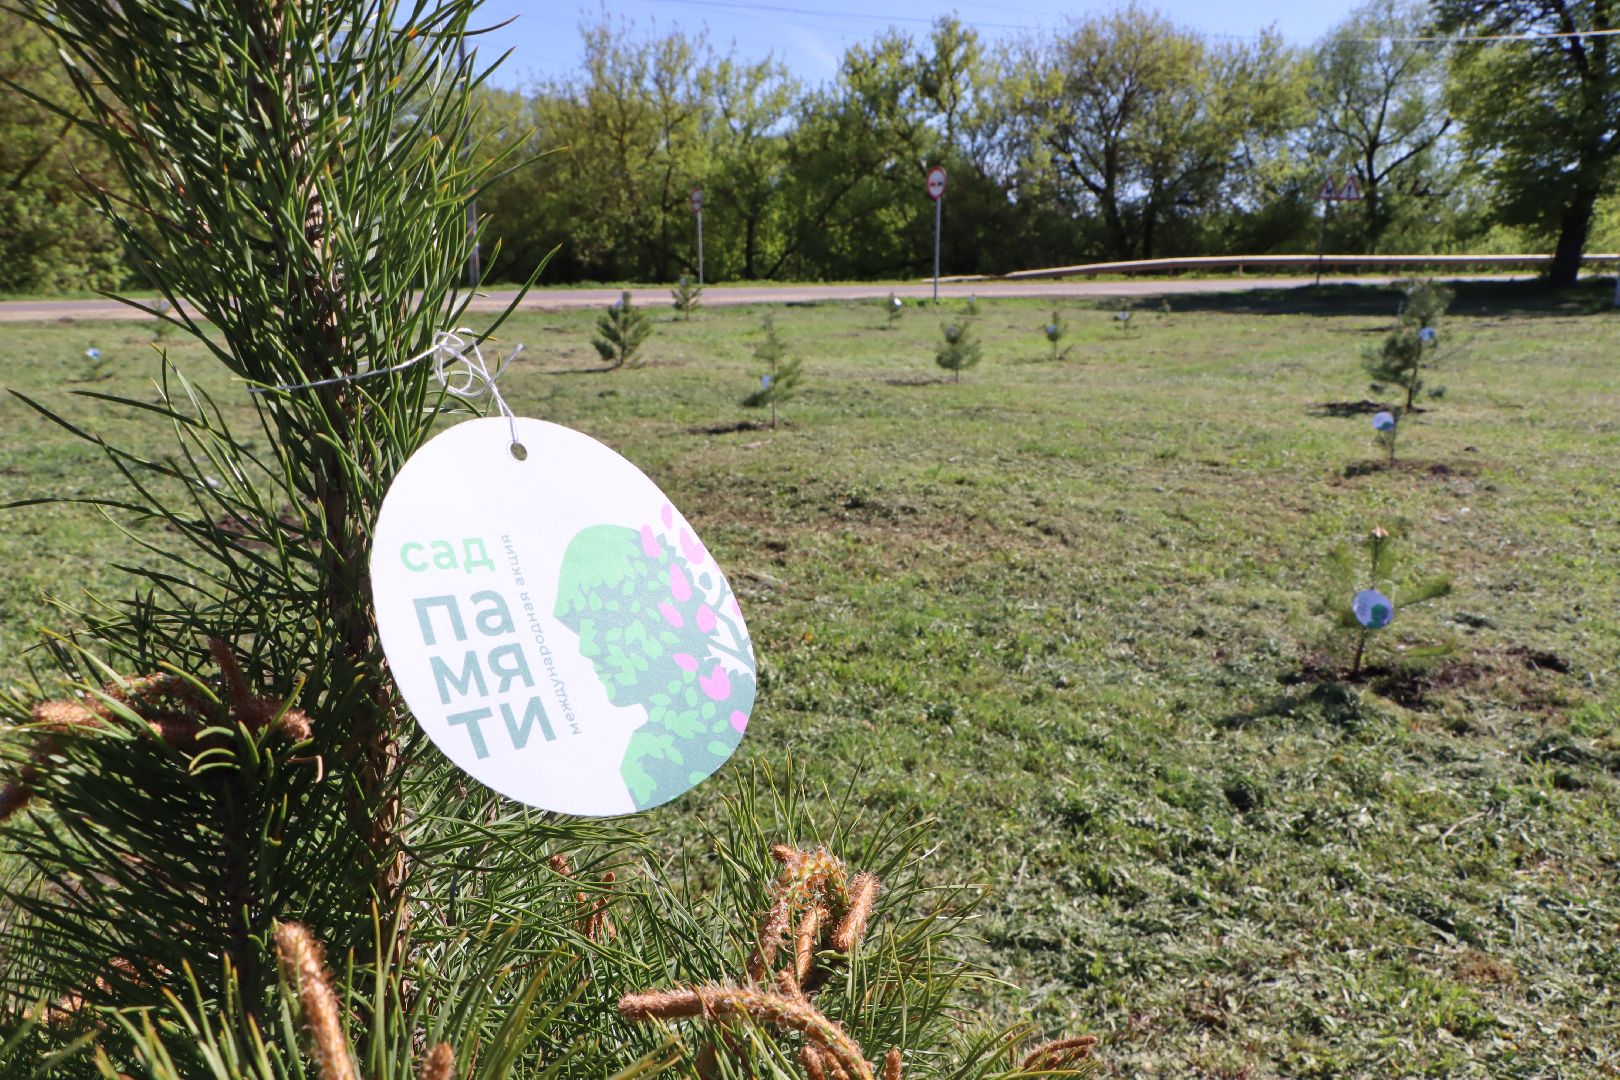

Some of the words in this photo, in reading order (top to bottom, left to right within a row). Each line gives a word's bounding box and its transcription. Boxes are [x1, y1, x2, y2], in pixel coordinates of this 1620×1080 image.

[400, 537, 496, 574] сад
[501, 534, 525, 587] акция
[520, 592, 582, 735] международная
